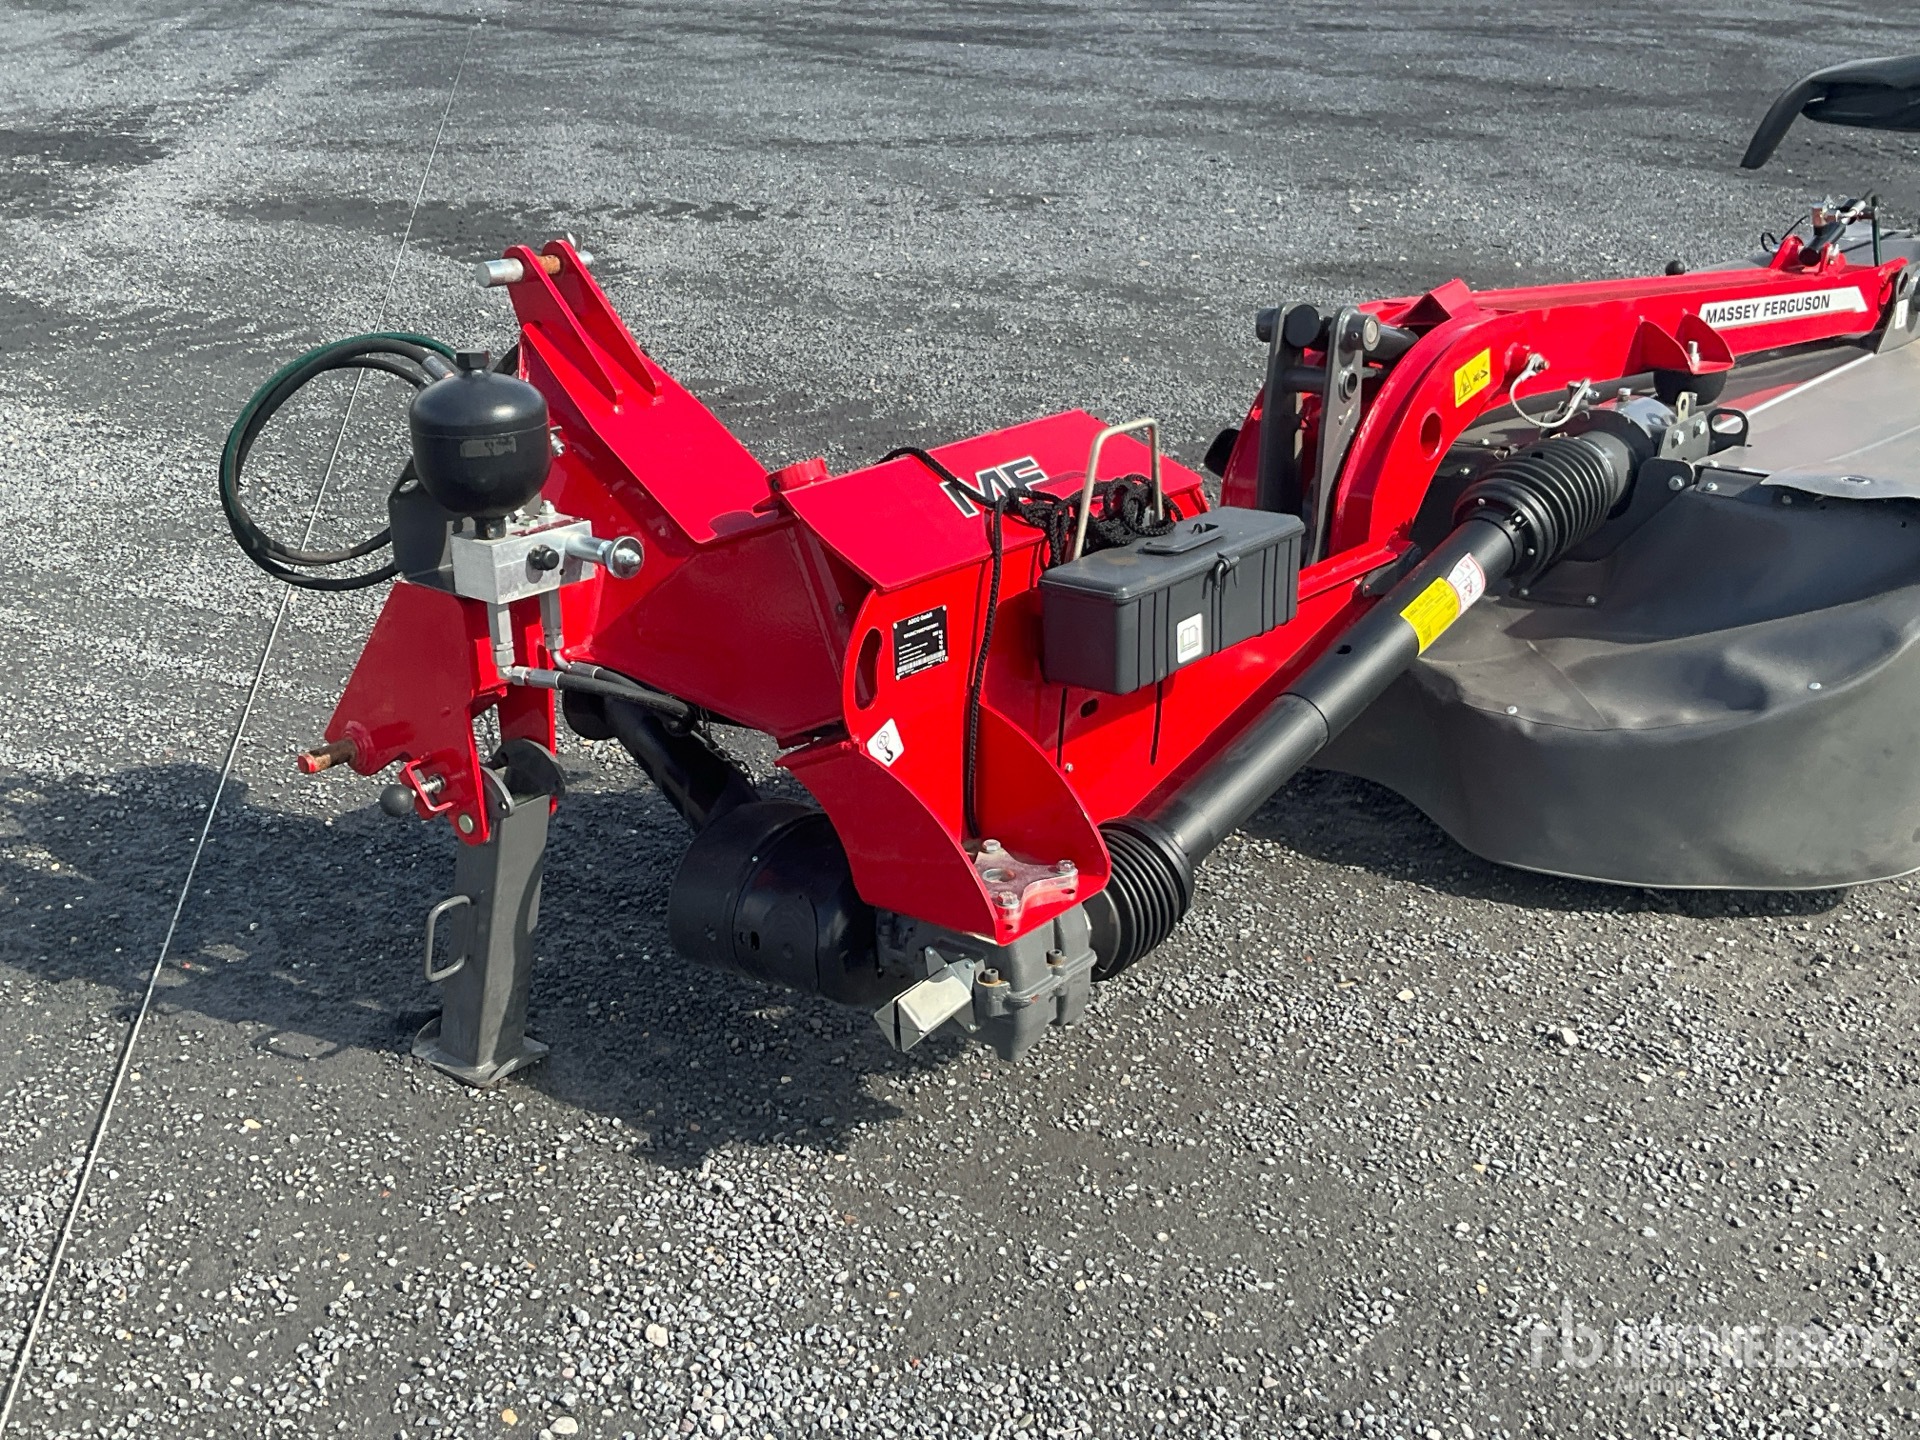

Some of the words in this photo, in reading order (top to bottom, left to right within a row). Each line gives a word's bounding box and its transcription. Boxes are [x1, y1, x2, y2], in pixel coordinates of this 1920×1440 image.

[1705, 302, 1761, 324] MASSEY
[1763, 294, 1831, 317] FERGUSON
[939, 455, 1050, 518] MF
